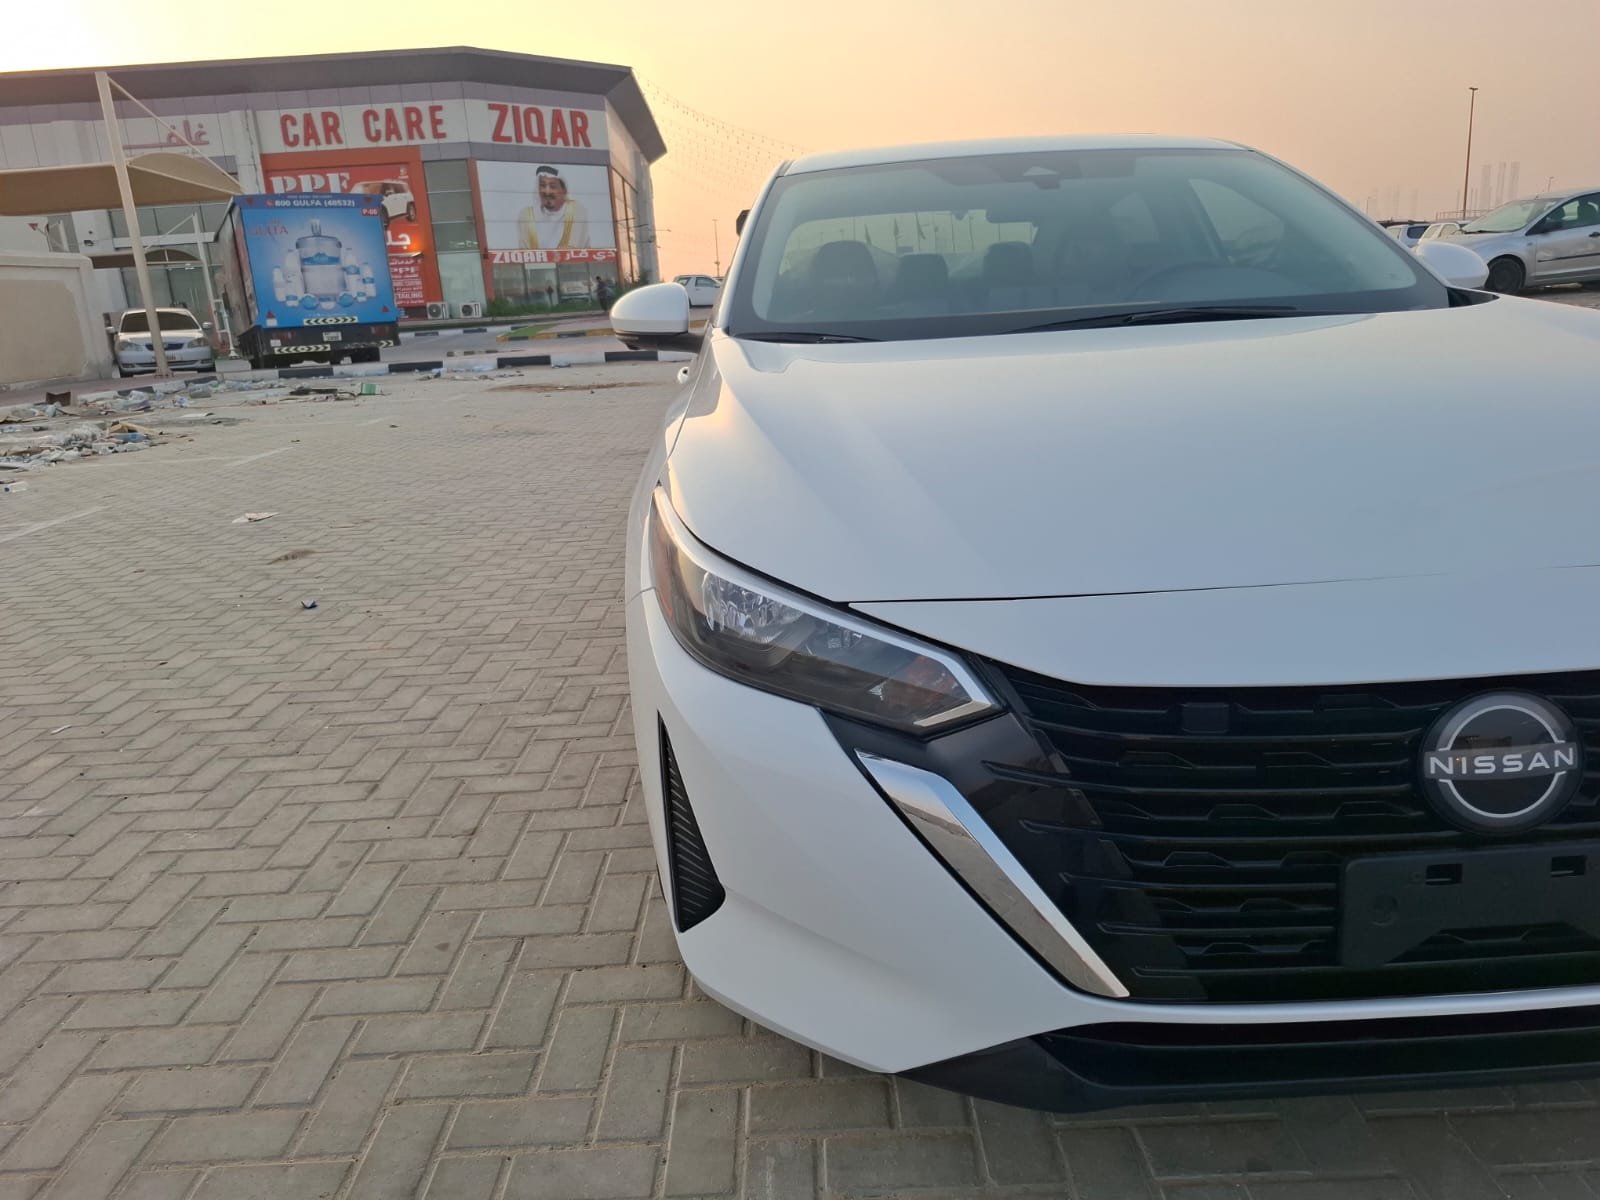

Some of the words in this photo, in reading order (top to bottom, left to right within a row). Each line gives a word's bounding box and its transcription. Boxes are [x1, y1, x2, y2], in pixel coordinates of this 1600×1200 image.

[280, 111, 343, 147] CAR
[362, 105, 447, 142] CARE
[488, 103, 592, 148] ZIQAR
[491, 251, 548, 263] ZIQAR
[1429, 747, 1574, 775] NISSAN
